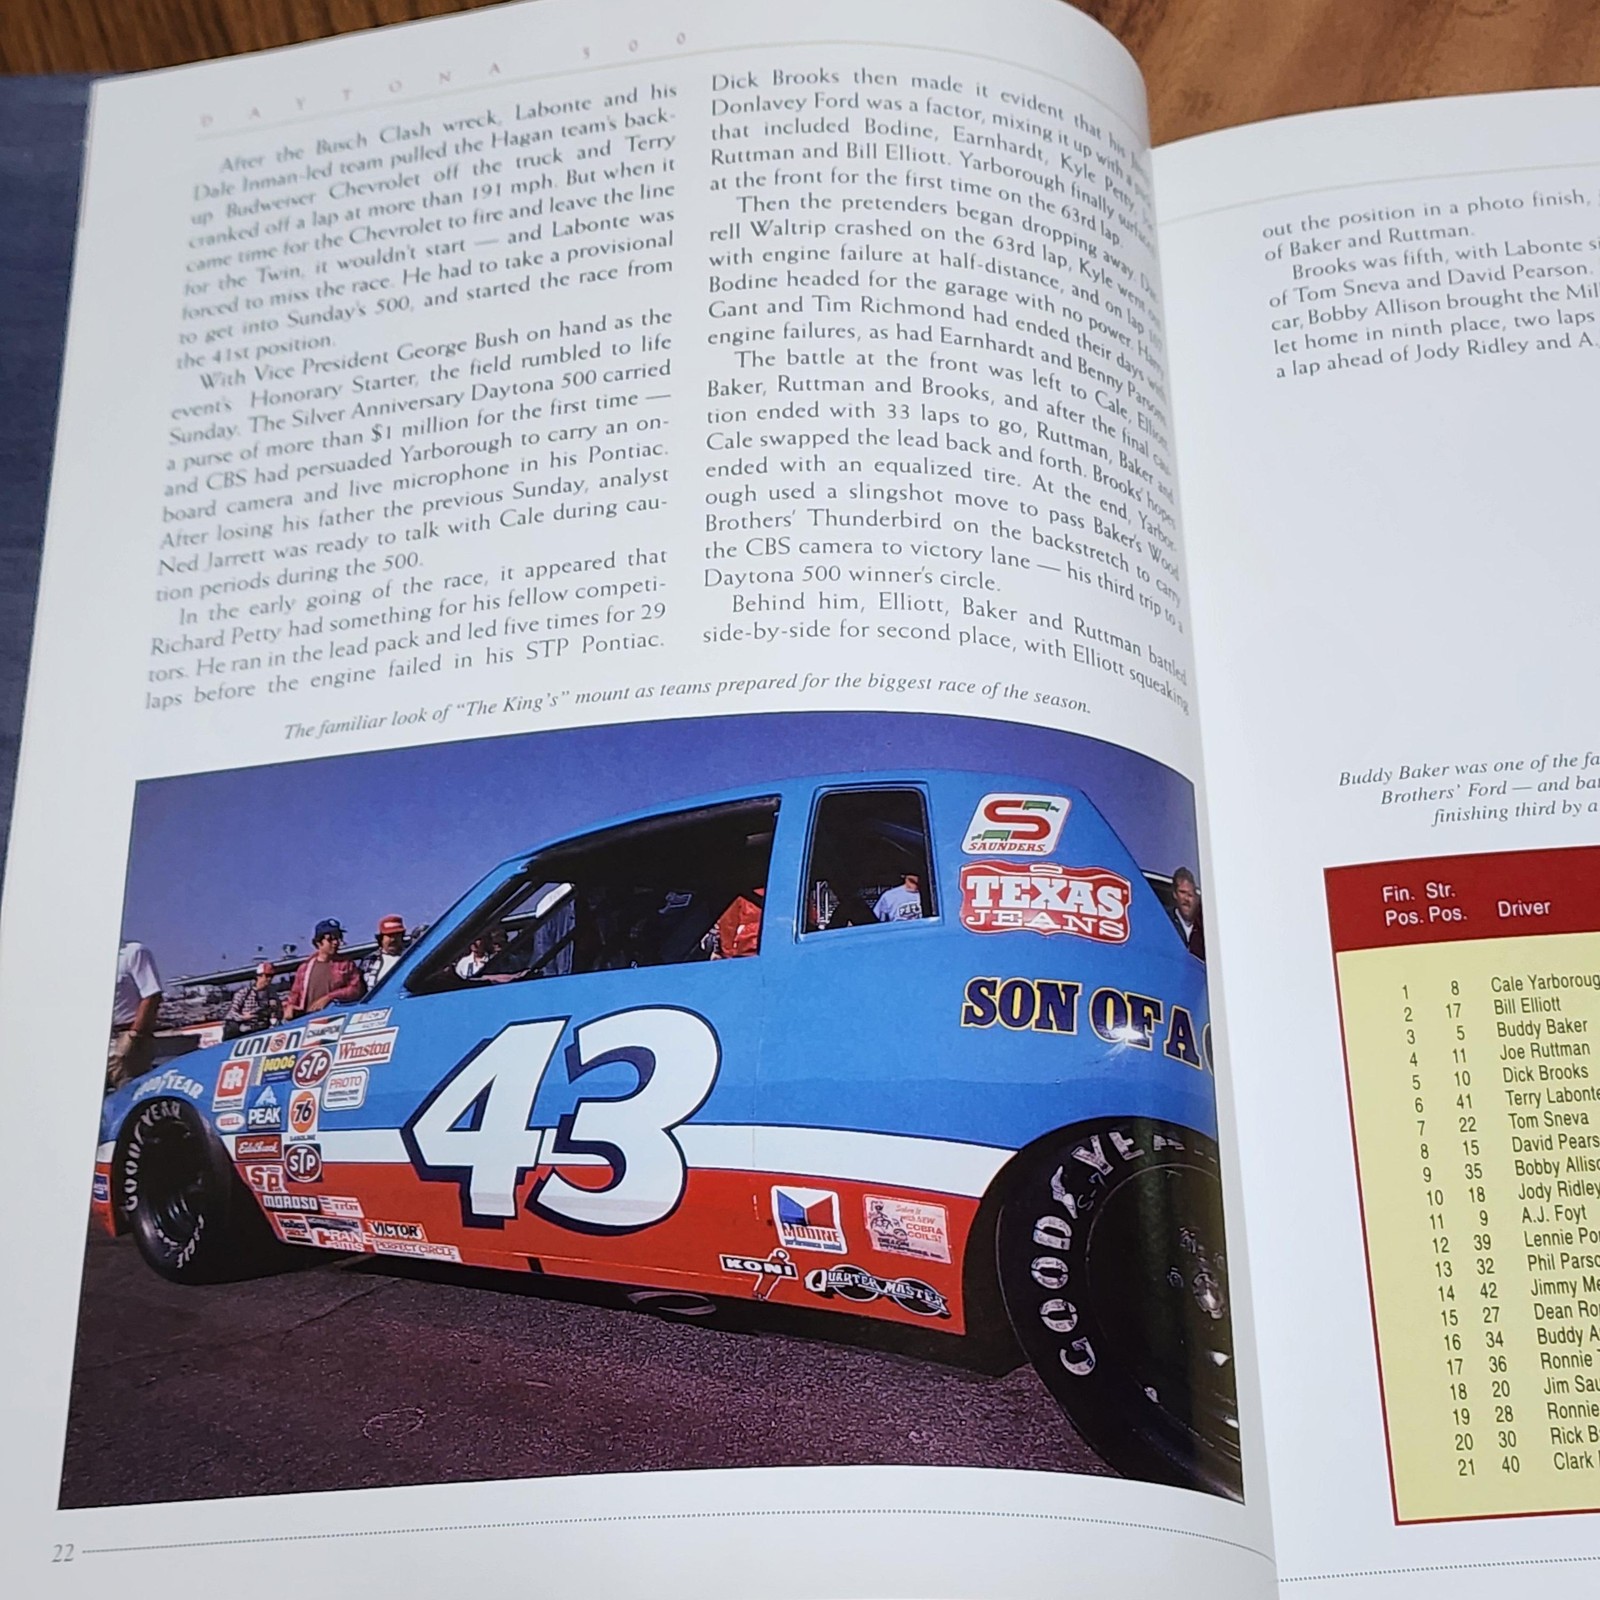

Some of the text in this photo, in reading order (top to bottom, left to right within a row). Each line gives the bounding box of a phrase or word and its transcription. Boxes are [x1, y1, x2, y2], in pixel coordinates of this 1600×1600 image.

[1262, 188, 1591, 239] out the position in a photo finish,
[1263, 226, 1476, 262] of Baker and Ruttman.
[164, 417, 669, 497] and CBS had persuaded Yarborough to carry an on-
[704, 563, 1002, 594] Daytona 500 winner's circle.
[732, 590, 1188, 687] Behind him, Elliott, Baker and Ruttman battled
[702, 617, 1190, 716] side-by-side for second place, with Elliott squeaking
[285, 723, 315, 740] The
[320, 714, 388, 736] familiar
[391, 707, 427, 727] look
[432, 706, 452, 724] of
[574, 687, 631, 705] mount
[634, 686, 655, 699] as
[660, 682, 712, 698] teams
[715, 673, 799, 697] prepared
[799, 673, 830, 693] for
[834, 673, 863, 690] the
[867, 673, 932, 693] biggest
[937, 680, 977, 694] race
[981, 682, 1003, 700] of
[1003, 684, 1029, 701] the
[1033, 692, 1091, 714] season.
[1338, 767, 1393, 787] Buddy
[1399, 763, 1450, 781] Baker
[1454, 763, 1488, 776] was
[1493, 760, 1525, 773] one
[1529, 753, 1550, 774] of
[1552, 752, 1579, 769] the
[1468, 779, 1508, 798] Ford
[1536, 776, 1571, 794] and
[1431, 799, 1599, 828] finishing third by a
[968, 841, 1047, 853] SAUNDERS
[965, 874, 1124, 920] TEXAS
[1382, 882, 1456, 903] Fin. Str.
[965, 908, 1126, 940] JEANS
[1385, 901, 1551, 927] Pos. Pos. Driver
[1402, 984, 1409, 1000] 1
[1450, 979, 1460, 997] 8
[1491, 976, 1523, 993] Cale
[1403, 997, 1561, 1023] 2 17 Bill Elliott
[960, 976, 1083, 1036] SON
[1089, 986, 1164, 1051] OF
[1163, 1005, 1203, 1071] A
[1406, 1018, 1587, 1045] 3 5 Buddy Baker
[338, 1039, 392, 1061] Winston
[1409, 1042, 1590, 1067] 4 11 Joe Ruttman
[263, 1055, 296, 1072] MOOG
[297, 1051, 327, 1080] STP
[329, 1076, 362, 1089] PROTO
[1412, 1063, 1589, 1091] 5 10 Dick Brooks
[294, 1099, 312, 1120] 76
[1414, 1096, 1424, 1114] 6
[1456, 1093, 1473, 1110] 41
[1505, 1090, 1541, 1109] Terry
[248, 1106, 281, 1126] PEAK
[400, 1003, 723, 1237] 43
[1416, 1110, 1589, 1137] 7 22 Tom Sneva
[288, 1148, 317, 1174] STP
[263, 1195, 319, 1211] MOROSO
[372, 1222, 418, 1237] VICTOR
[783, 1222, 841, 1244] MODINE
[906, 1223, 944, 1236] COBRA
[375, 1241, 454, 1257] PERFECT CIRCLE
[725, 1257, 794, 1276] KONI
[804, 1268, 949, 1314] QUARTER MASTER
[1458, 1451, 1594, 1476] 21 40 Clark
[51, 1543, 75, 1563] 22
